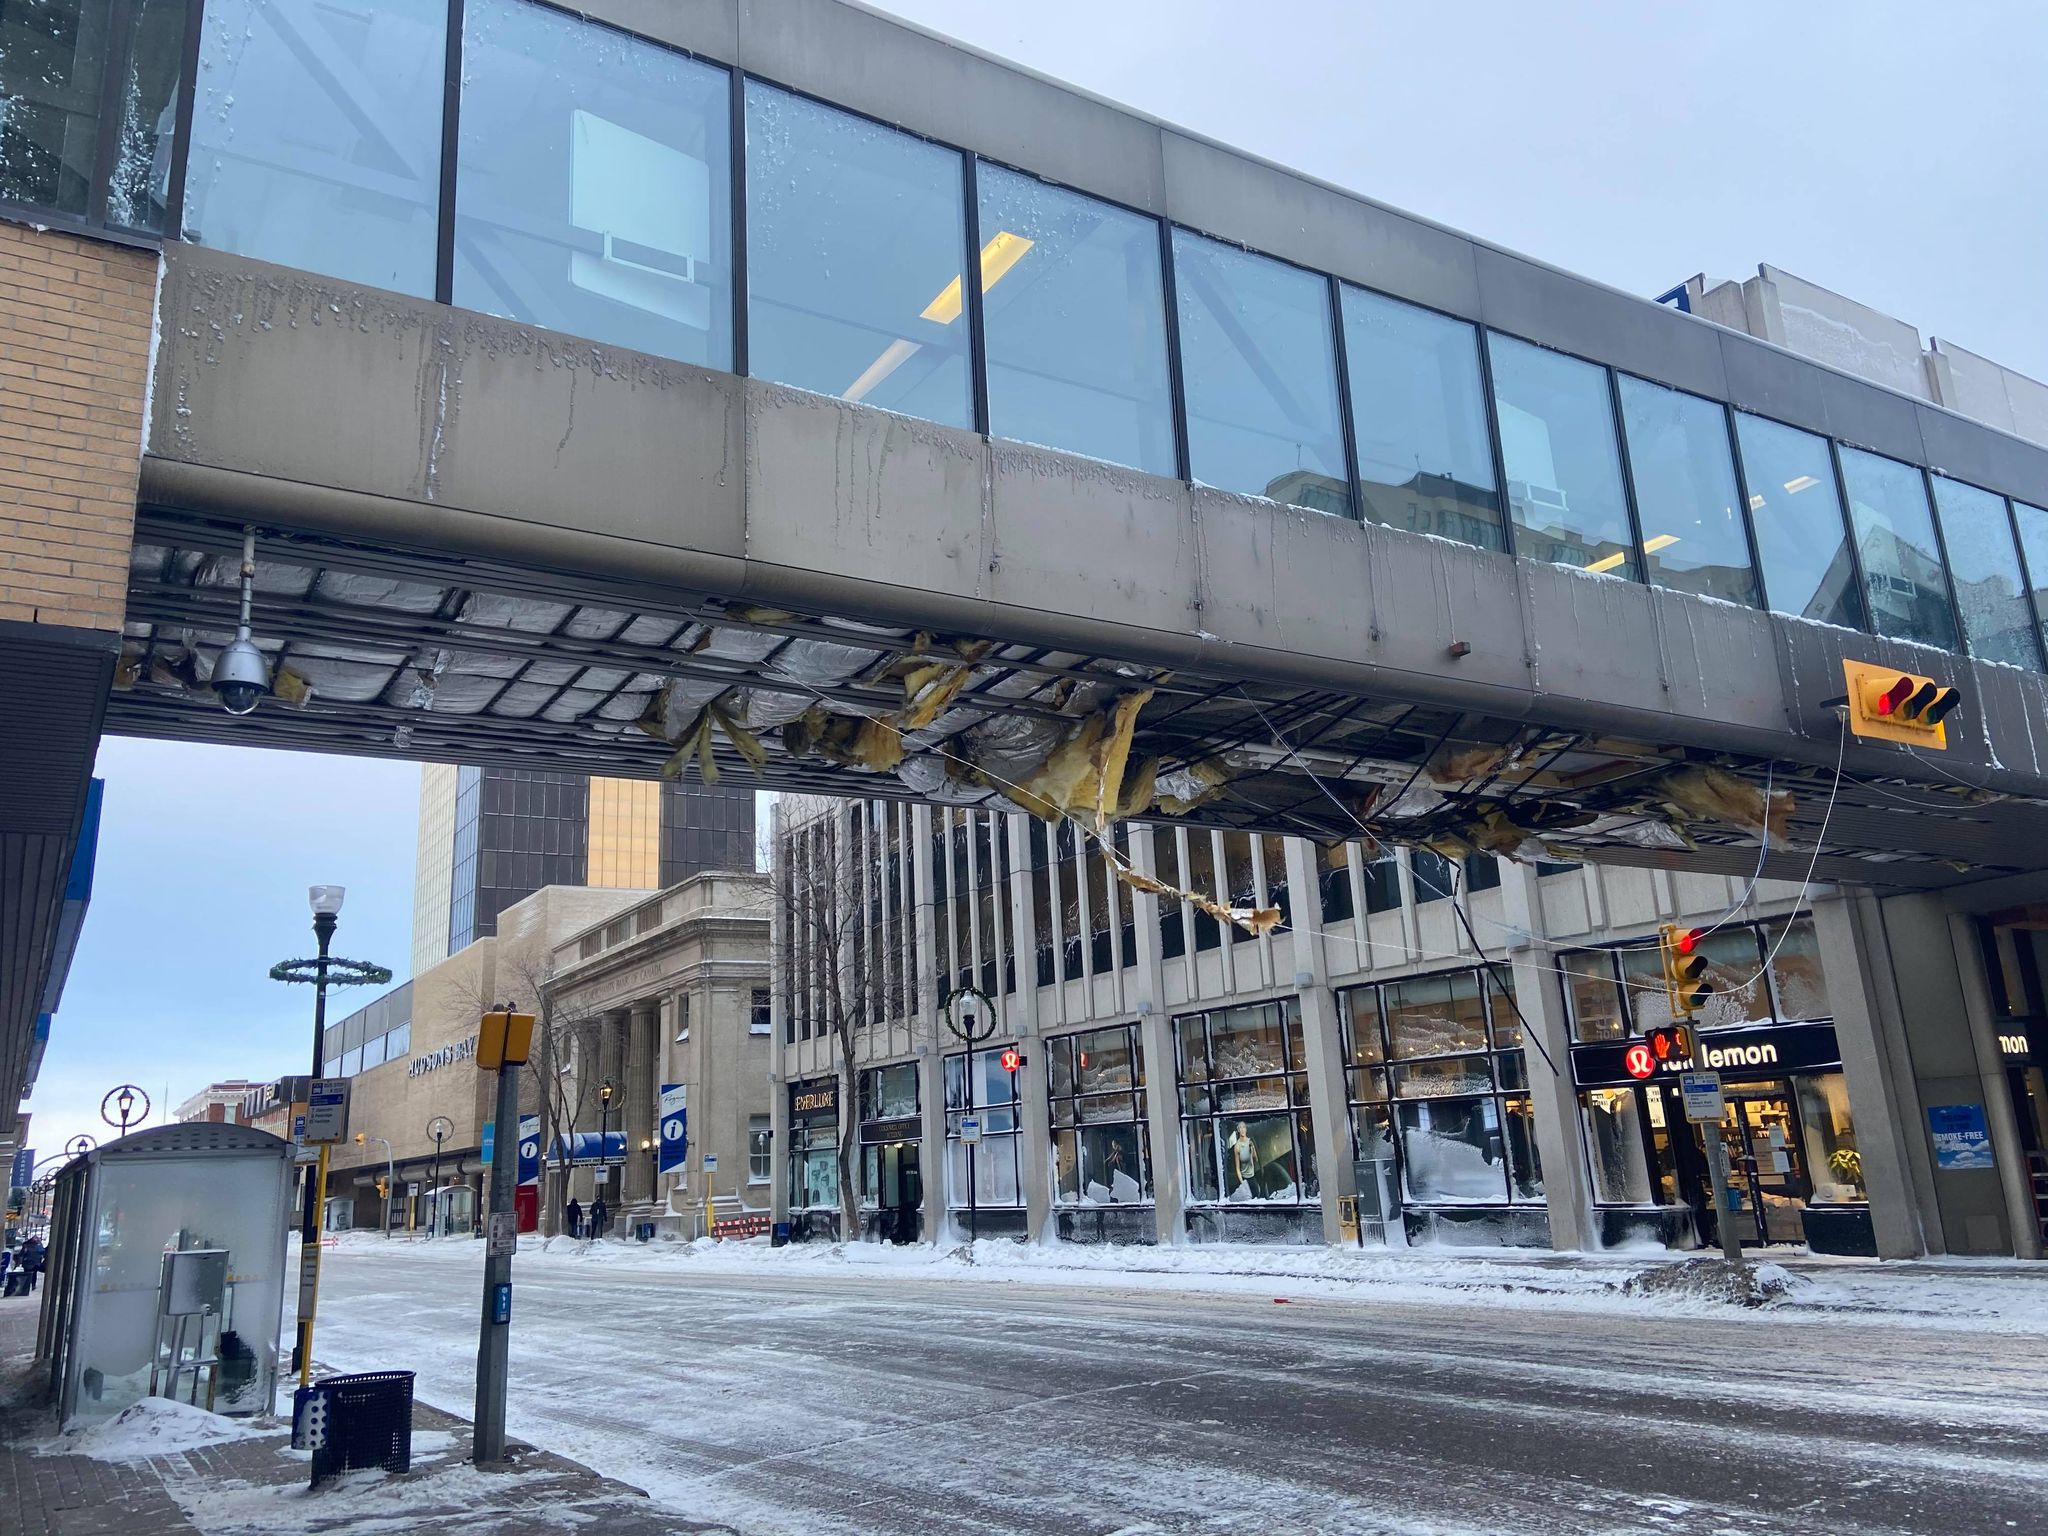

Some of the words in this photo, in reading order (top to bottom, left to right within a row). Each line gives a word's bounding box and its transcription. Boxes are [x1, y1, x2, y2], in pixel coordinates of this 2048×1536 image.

[409, 1045, 453, 1078] HUDSON'S
[454, 1036, 476, 1061] BAY
[1661, 1043, 1778, 1072] ulemon
[1936, 1131, 1984, 1142] SMOKE-FREE
